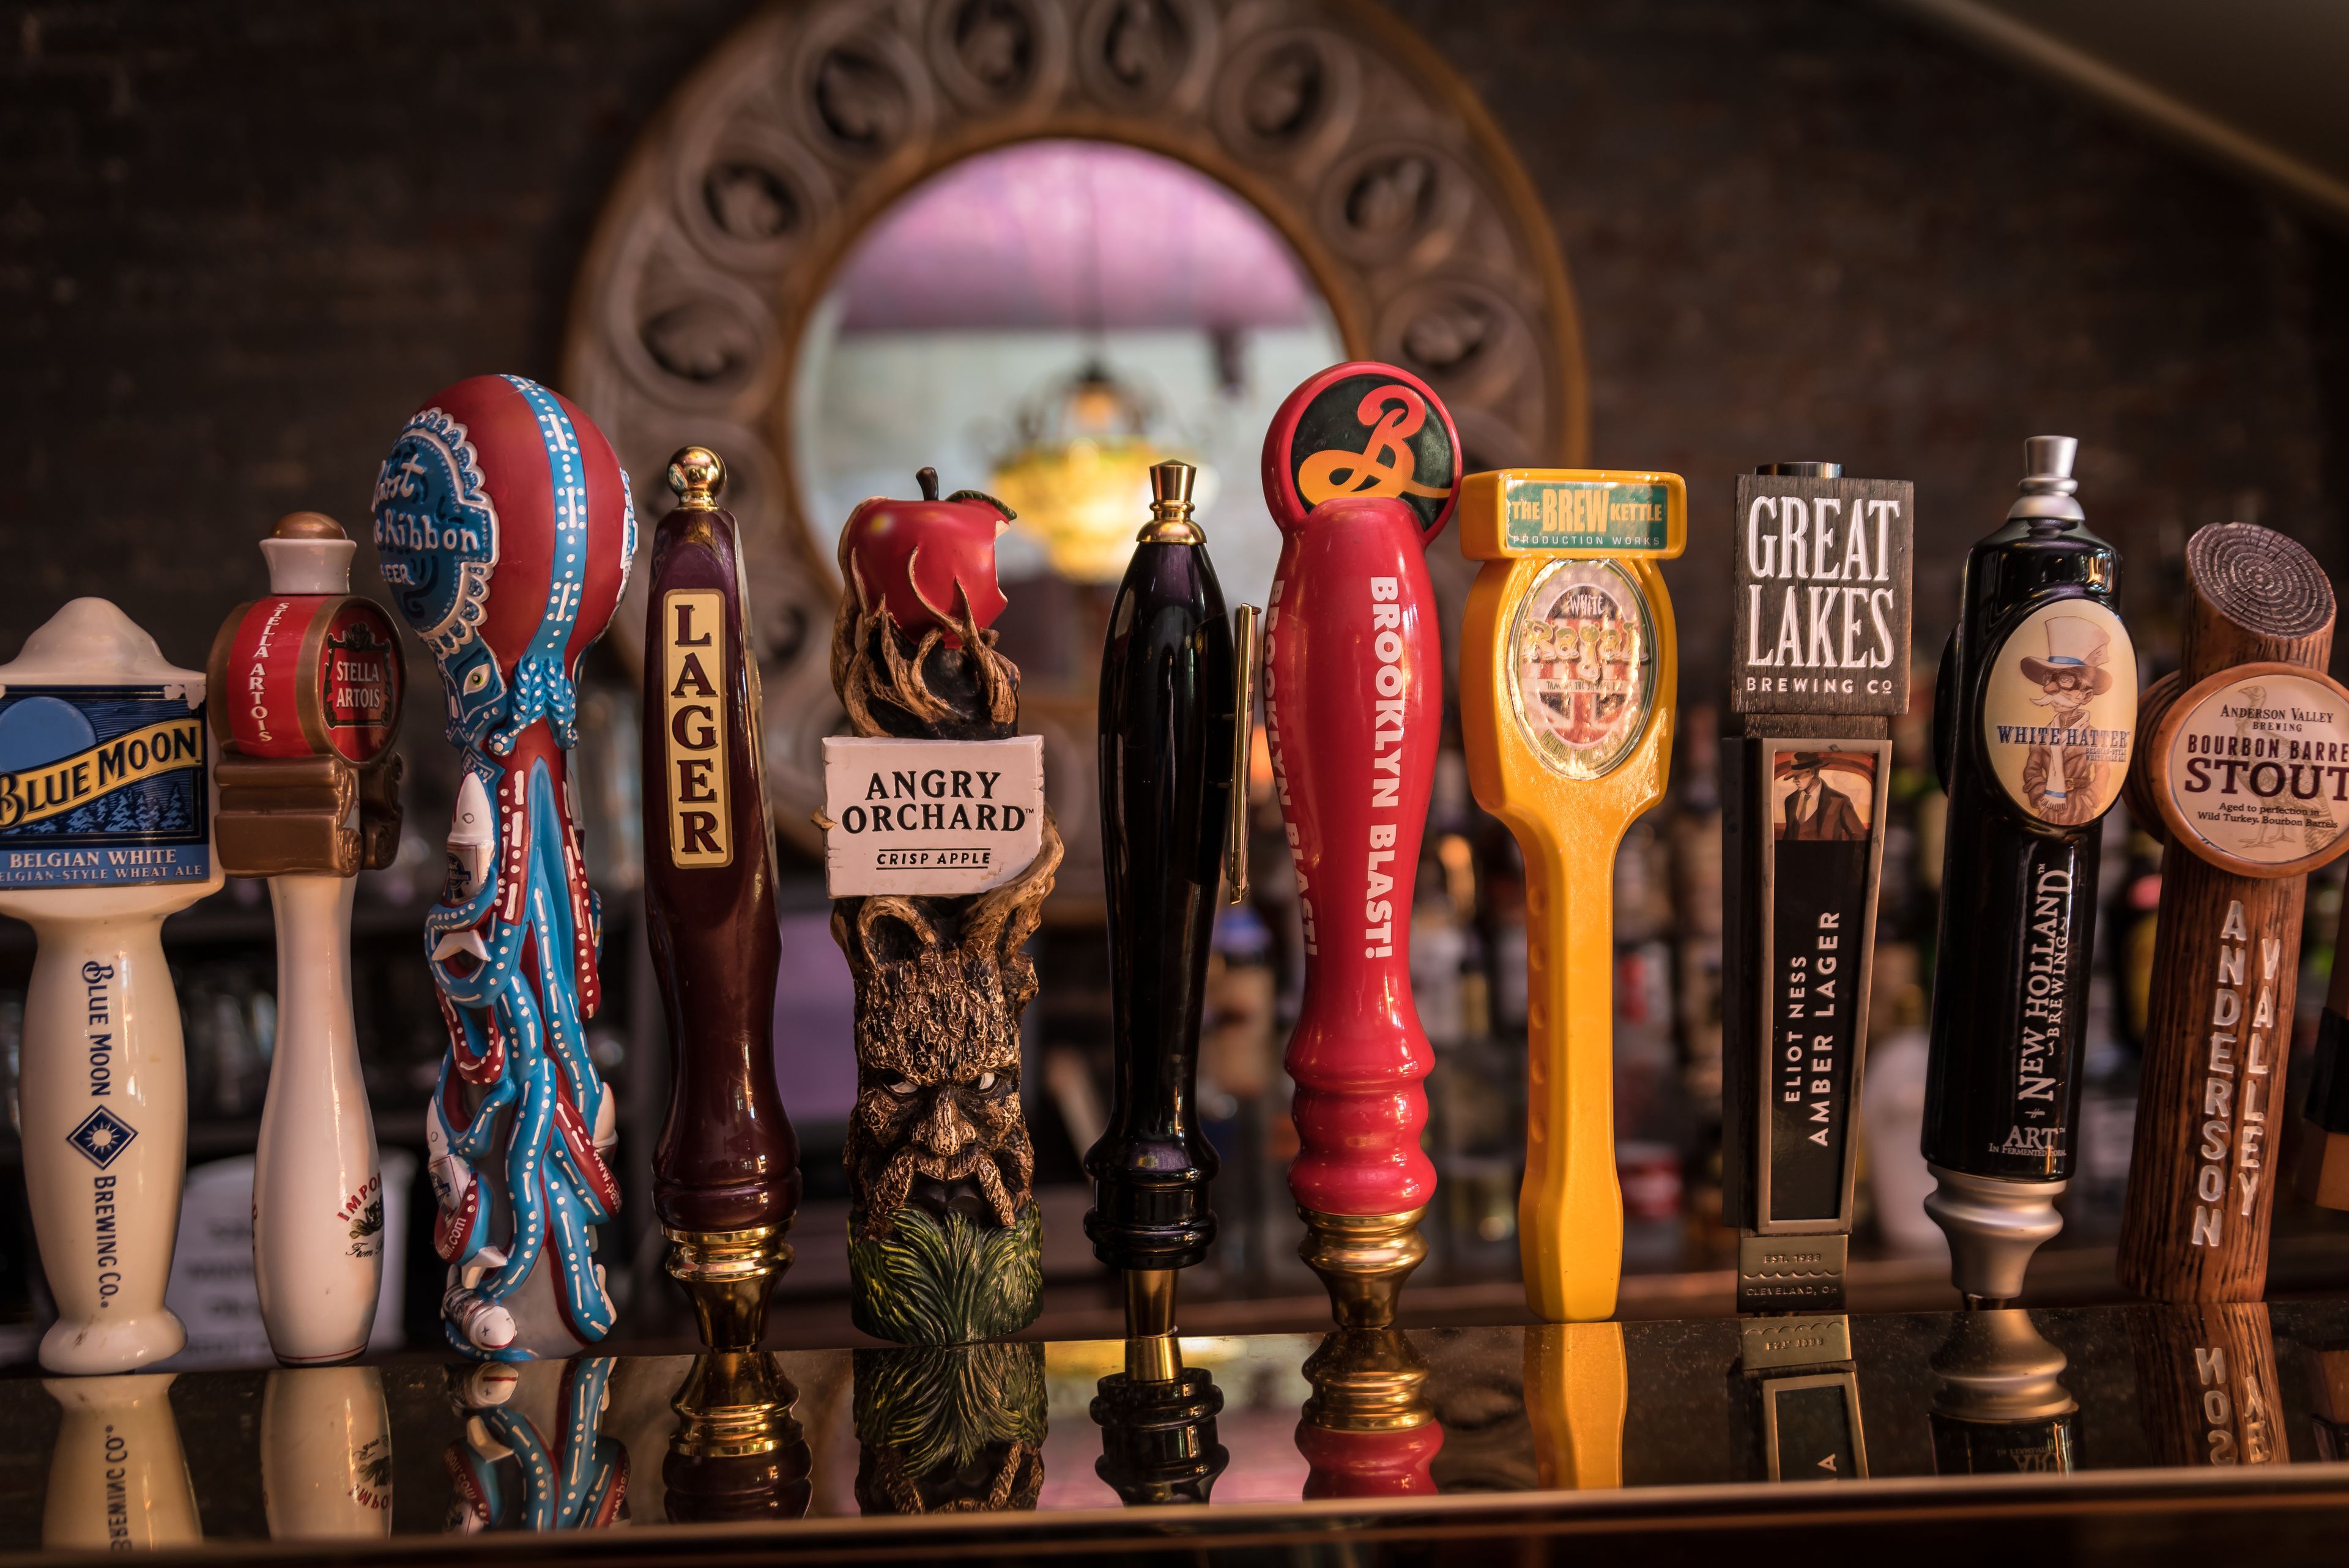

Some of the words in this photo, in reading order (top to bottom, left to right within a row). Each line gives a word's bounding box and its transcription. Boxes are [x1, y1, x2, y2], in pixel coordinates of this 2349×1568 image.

[1512, 500, 1540, 519] THE
[1542, 489, 1610, 532] BREW
[1610, 503, 1663, 521] KETTLE
[1513, 536, 1603, 544] PRODUCTION
[1613, 537, 1660, 545] WORKS
[1748, 496, 1900, 581] GREAT
[253, 603, 290, 658] STELLA
[1748, 584, 1894, 669] LAKES
[336, 660, 379, 682] STELLA
[1371, 577, 1405, 807] BROOKLYN
[1746, 677, 1854, 693] BREWING
[248, 663, 273, 741] ARTOIS
[336, 687, 380, 708] ARTOIS
[2220, 704, 2286, 719] ANDERSON
[2291, 708, 2334, 723] VALLEY
[670, 604, 724, 854] LAGER
[1997, 725, 2061, 746] WHITE
[2066, 728, 2129, 748] HATTER
[2188, 734, 2280, 758] BOURBON
[2290, 739, 2349, 763] BARRE
[2252, 721, 2303, 732] BREWING
[0, 762, 91, 827] BLUE
[97, 726, 198, 790] MOON
[864, 769, 1001, 800] ANGRY
[2184, 757, 2349, 801] STOUT
[2197, 811, 2220, 821] Wild
[2262, 815, 2303, 826] Bourbon
[2305, 819, 2338, 828] Barrels
[2219, 802, 2244, 813] Aged
[2247, 804, 2257, 812] to
[2259, 805, 2308, 816] perfection
[2310, 808, 2320, 817] in
[0, 869, 108, 882] ELGIAN-STYLE
[115, 866, 168, 879] WHEAT
[175, 864, 202, 876] ALE
[10, 851, 100, 869] BELGIAN
[108, 849, 177, 866] WHITE
[877, 853, 929, 865] CRISP
[937, 853, 991, 864] APPLE
[1365, 824, 1397, 959] BLAST!
[1788, 956, 1806, 1019] NESS
[1814, 912, 1839, 1016] LAGER
[2047, 935, 2068, 1038] BREWING
[81, 960, 114, 1025] BLUE
[89, 1034, 113, 1097] MOON
[1785, 1031, 1803, 1102] ELIOT
[2018, 1027, 2057, 1102] NEW
[2192, 899, 2247, 1247] ANDERSON
[2238, 938, 2280, 1216] VALLEY
[1809, 1035, 1833, 1146] AMBER
[1989, 1142, 1999, 1153] IN
[2002, 1145, 2046, 1156] FERMENTED
[94, 1175, 117, 1268] BREWING
[345, 1242, 373, 1258] From
[1764, 1254, 1789, 1264] EST.
